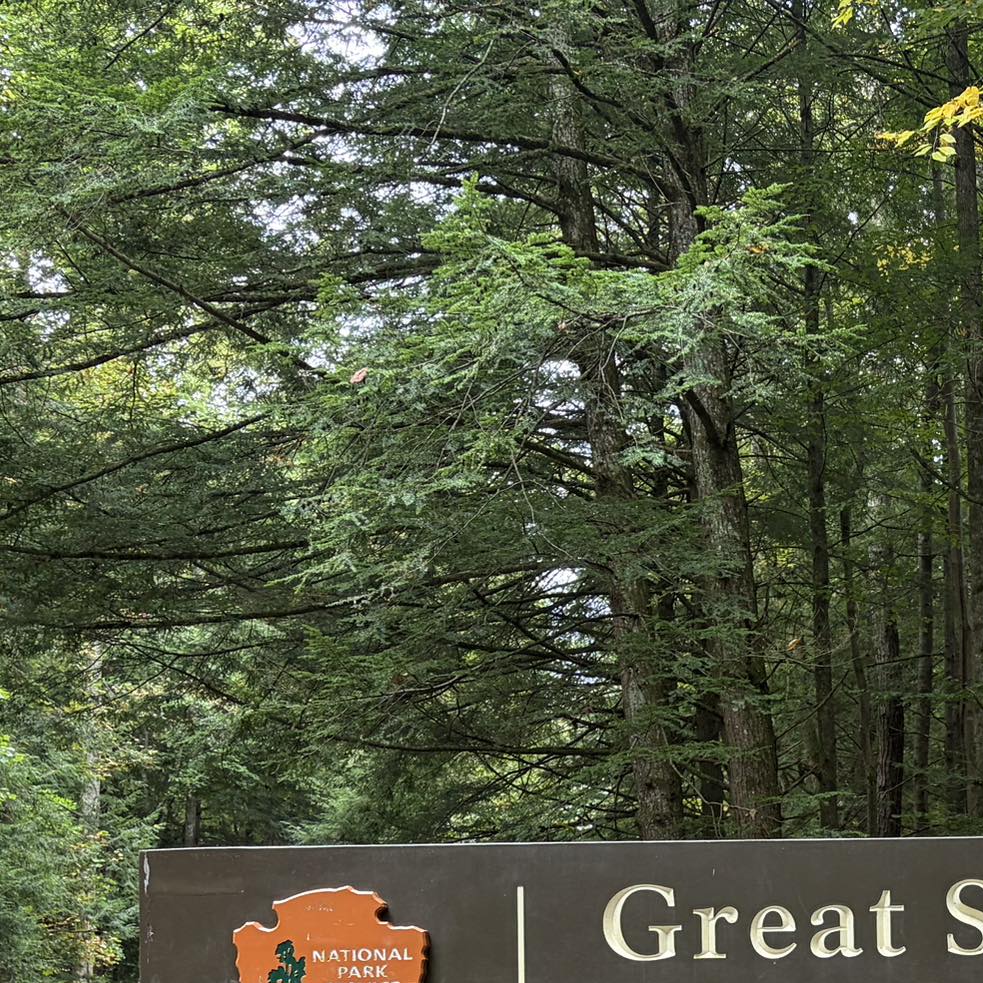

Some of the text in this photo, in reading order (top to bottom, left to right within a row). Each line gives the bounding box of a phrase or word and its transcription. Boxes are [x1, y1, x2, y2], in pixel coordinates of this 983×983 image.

[603, 884, 906, 960] Great
[312, 948, 413, 962] NATIONAL
[337, 964, 388, 978] PARK
